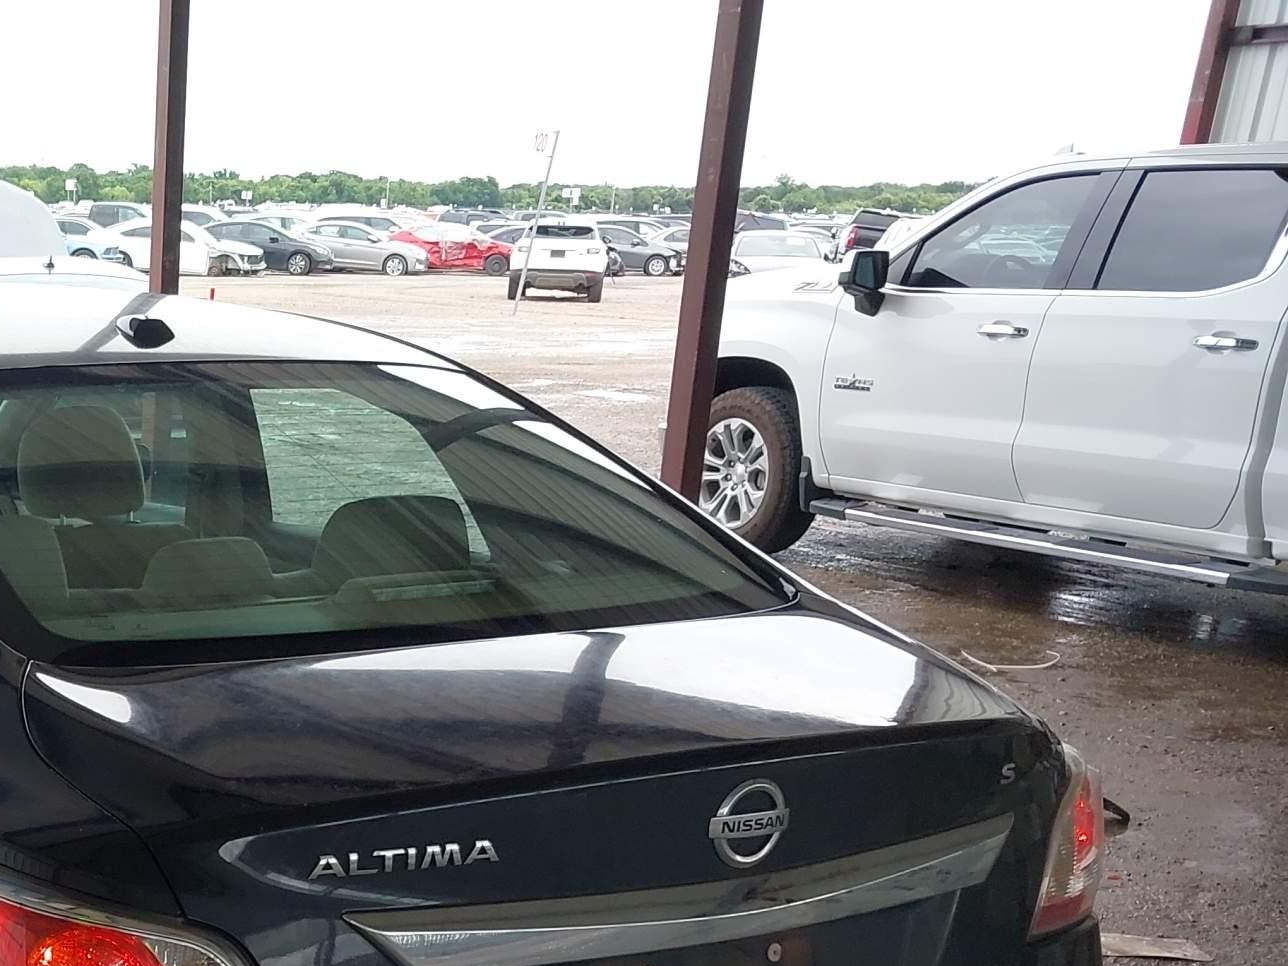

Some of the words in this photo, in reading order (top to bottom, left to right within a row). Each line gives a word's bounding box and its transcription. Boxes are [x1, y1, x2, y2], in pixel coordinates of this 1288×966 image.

[999, 762, 1016, 784] S
[721, 815, 785, 834] NISSAN
[309, 839, 500, 880] ALTIMA
